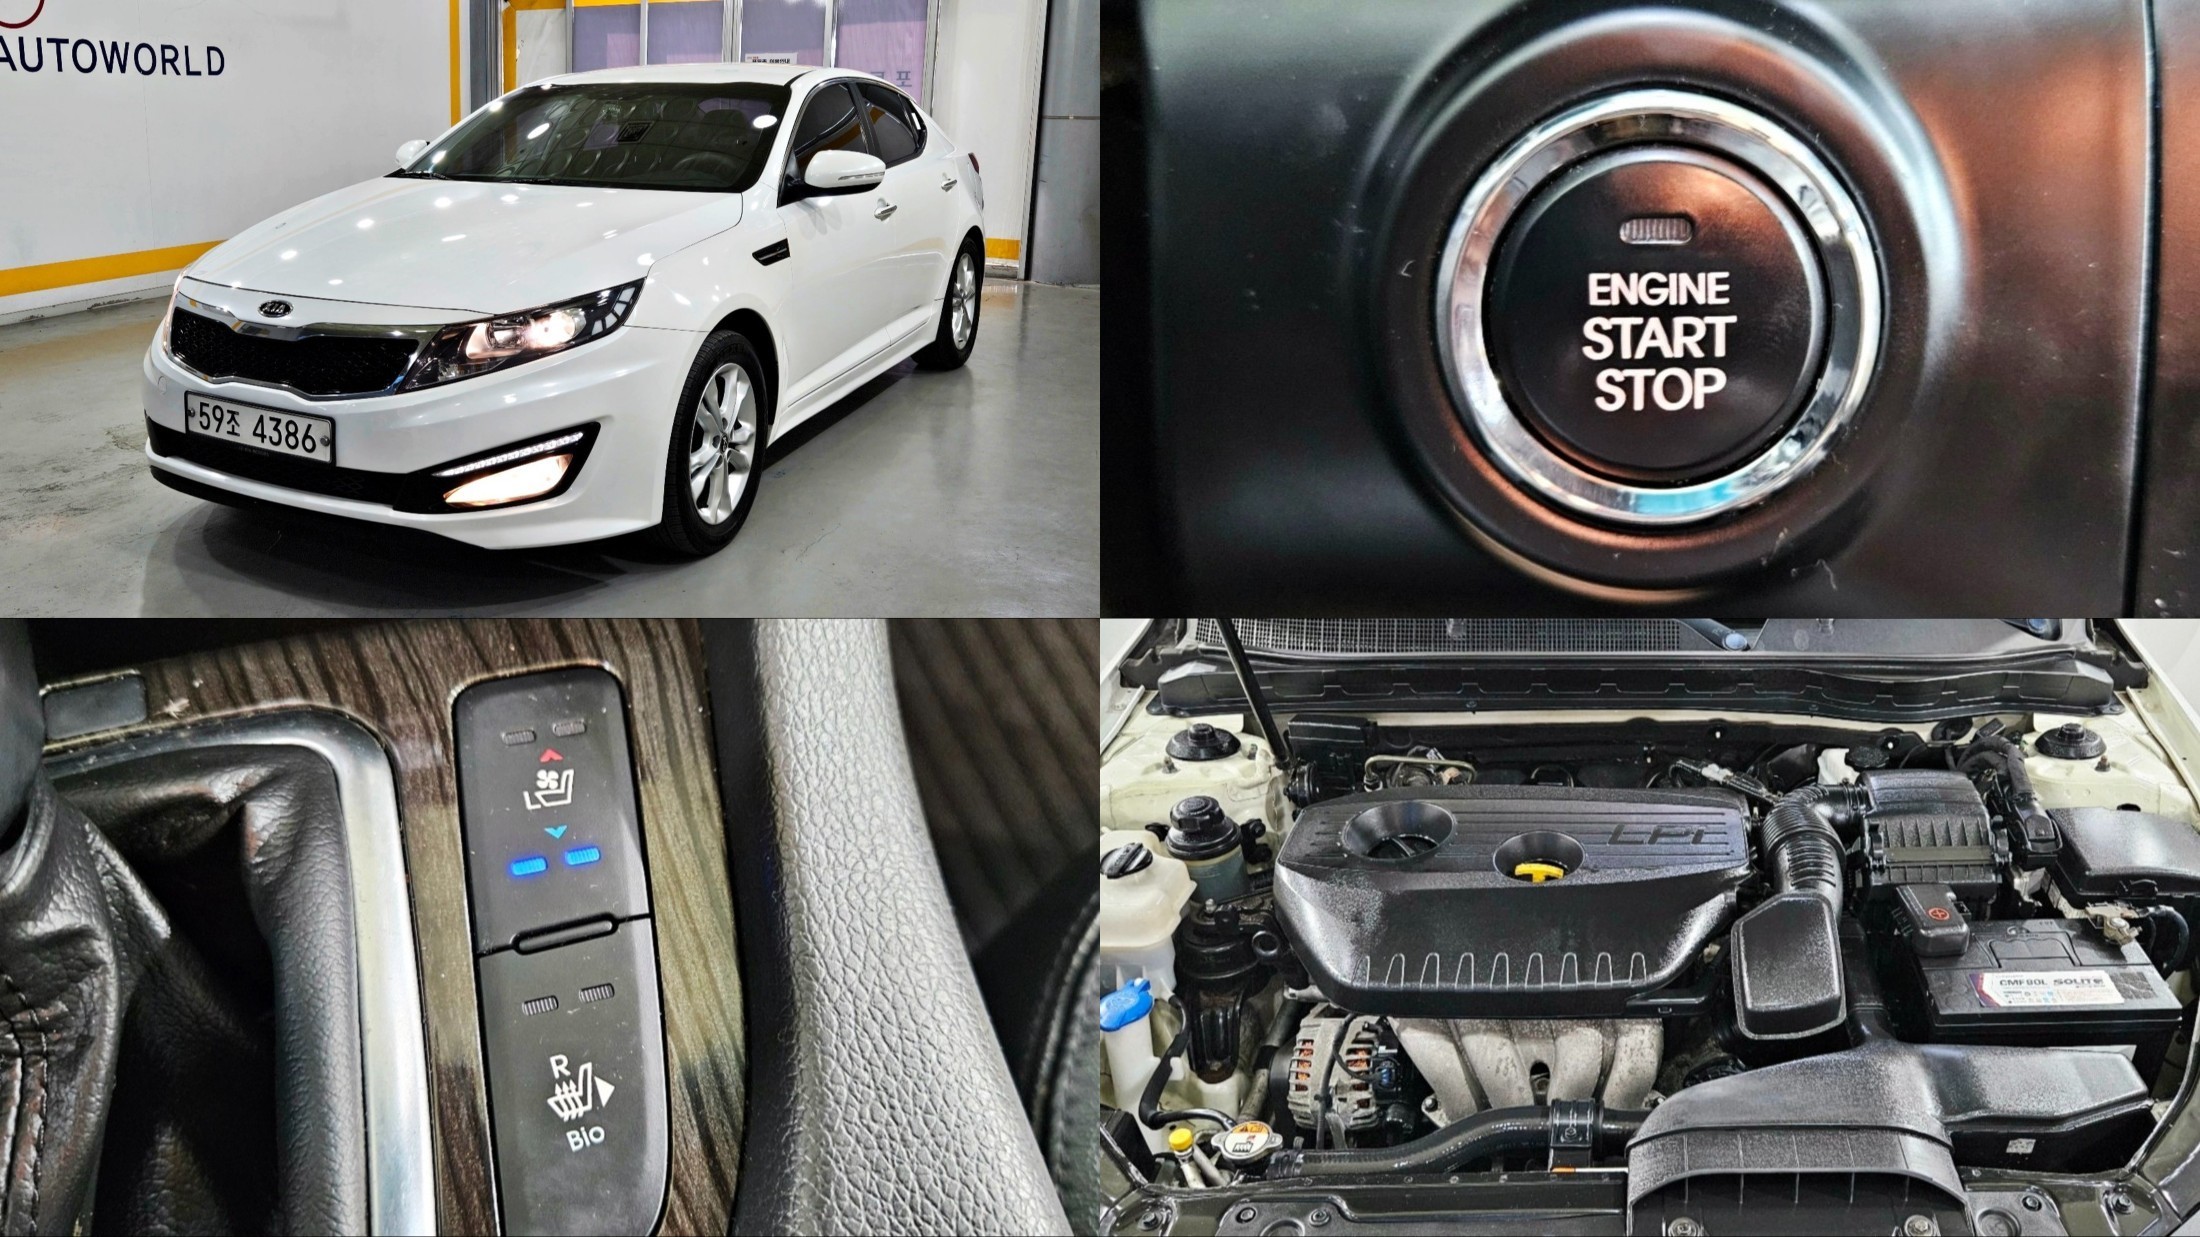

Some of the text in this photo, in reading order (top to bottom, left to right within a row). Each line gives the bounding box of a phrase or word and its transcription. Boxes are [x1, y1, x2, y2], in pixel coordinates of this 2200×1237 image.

[1588, 272, 1730, 306] ENGINE
[1582, 315, 1738, 361] START
[1595, 367, 1727, 412] STOP
[199, 402, 316, 453] 59조 4386
[550, 1054, 571, 1079] R
[566, 1126, 605, 1152] Bio
